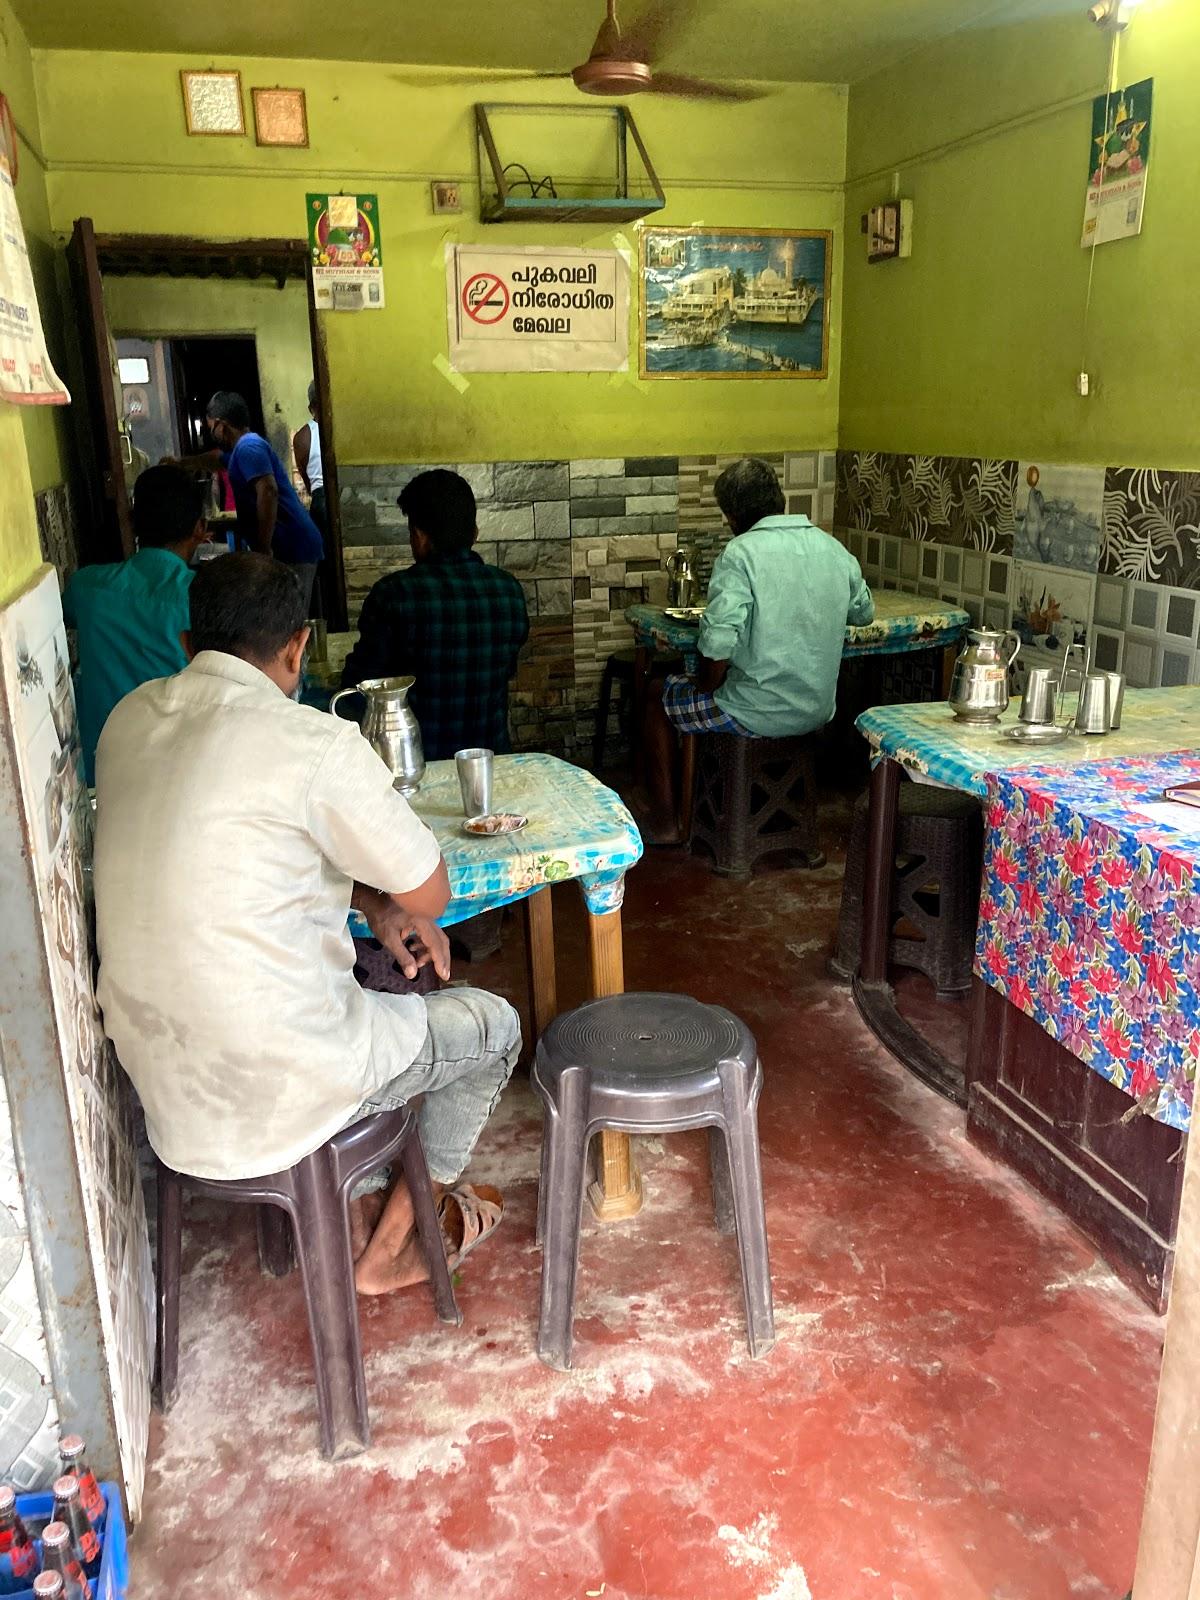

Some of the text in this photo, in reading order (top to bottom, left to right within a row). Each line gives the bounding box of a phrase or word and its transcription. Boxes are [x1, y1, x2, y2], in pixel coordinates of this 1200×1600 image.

[511, 263, 597, 287] പുകവലി
[512, 287, 614, 310] നിരോധിത
[512, 317, 571, 334] മേഖല
